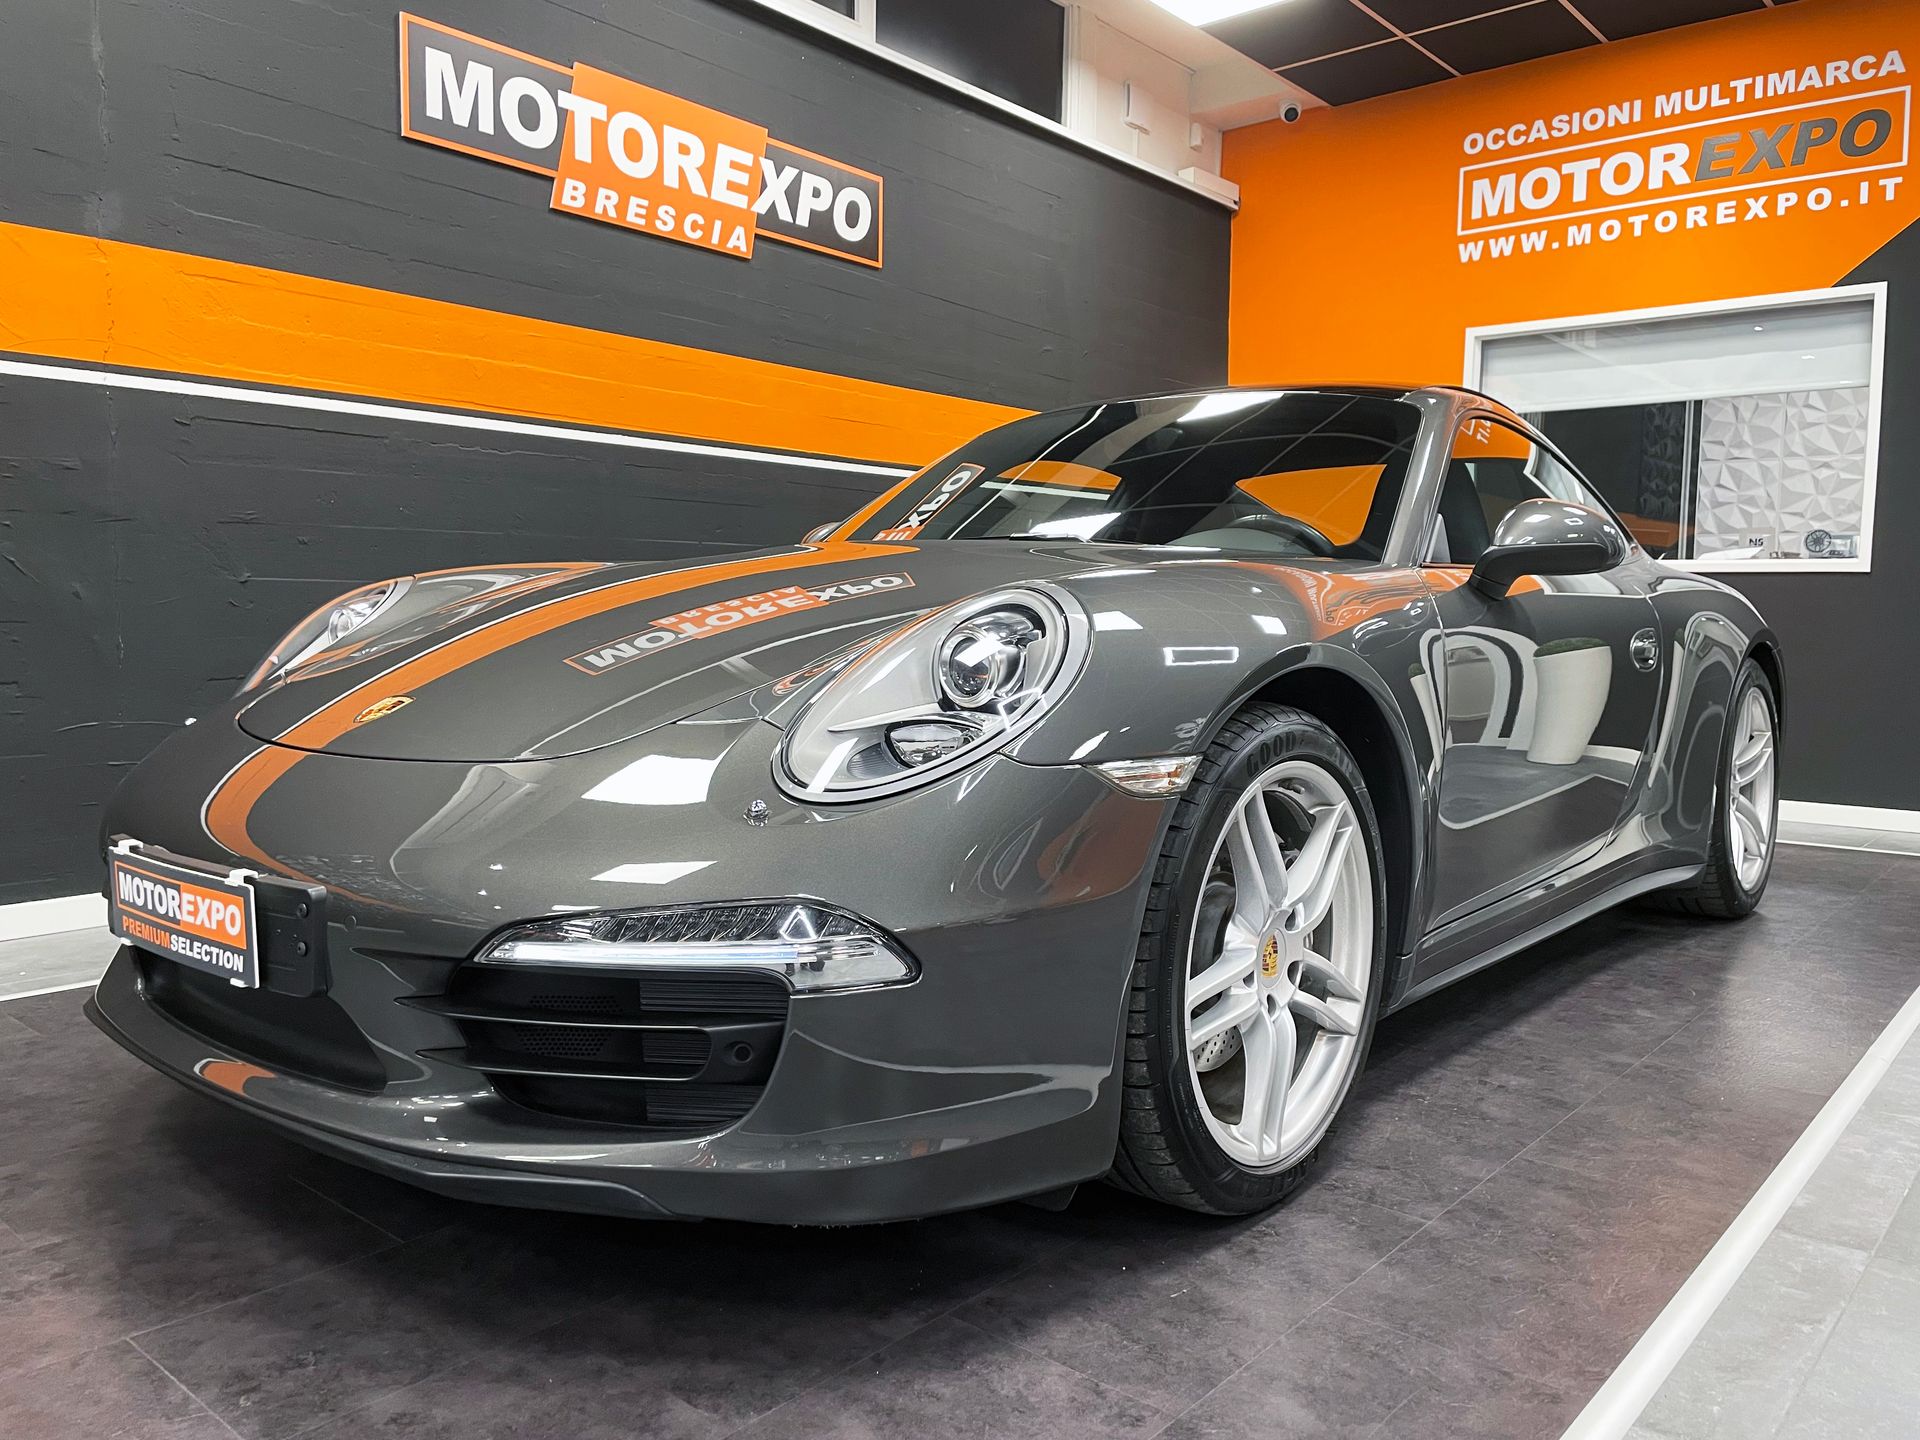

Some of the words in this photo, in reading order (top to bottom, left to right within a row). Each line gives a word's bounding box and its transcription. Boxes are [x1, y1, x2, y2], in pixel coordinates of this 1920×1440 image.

[424, 46, 872, 242] MOTOREXPO
[1463, 99, 1642, 155] OCCASIONI
[1654, 50, 1906, 118] MULTIMARCA
[1470, 109, 1892, 220] MOTOREXPO
[561, 178, 748, 252] BRESCIA
[1458, 176, 1904, 263] WWW.MOTOREXPO.IT
[119, 871, 242, 936] MOTOREXPO
